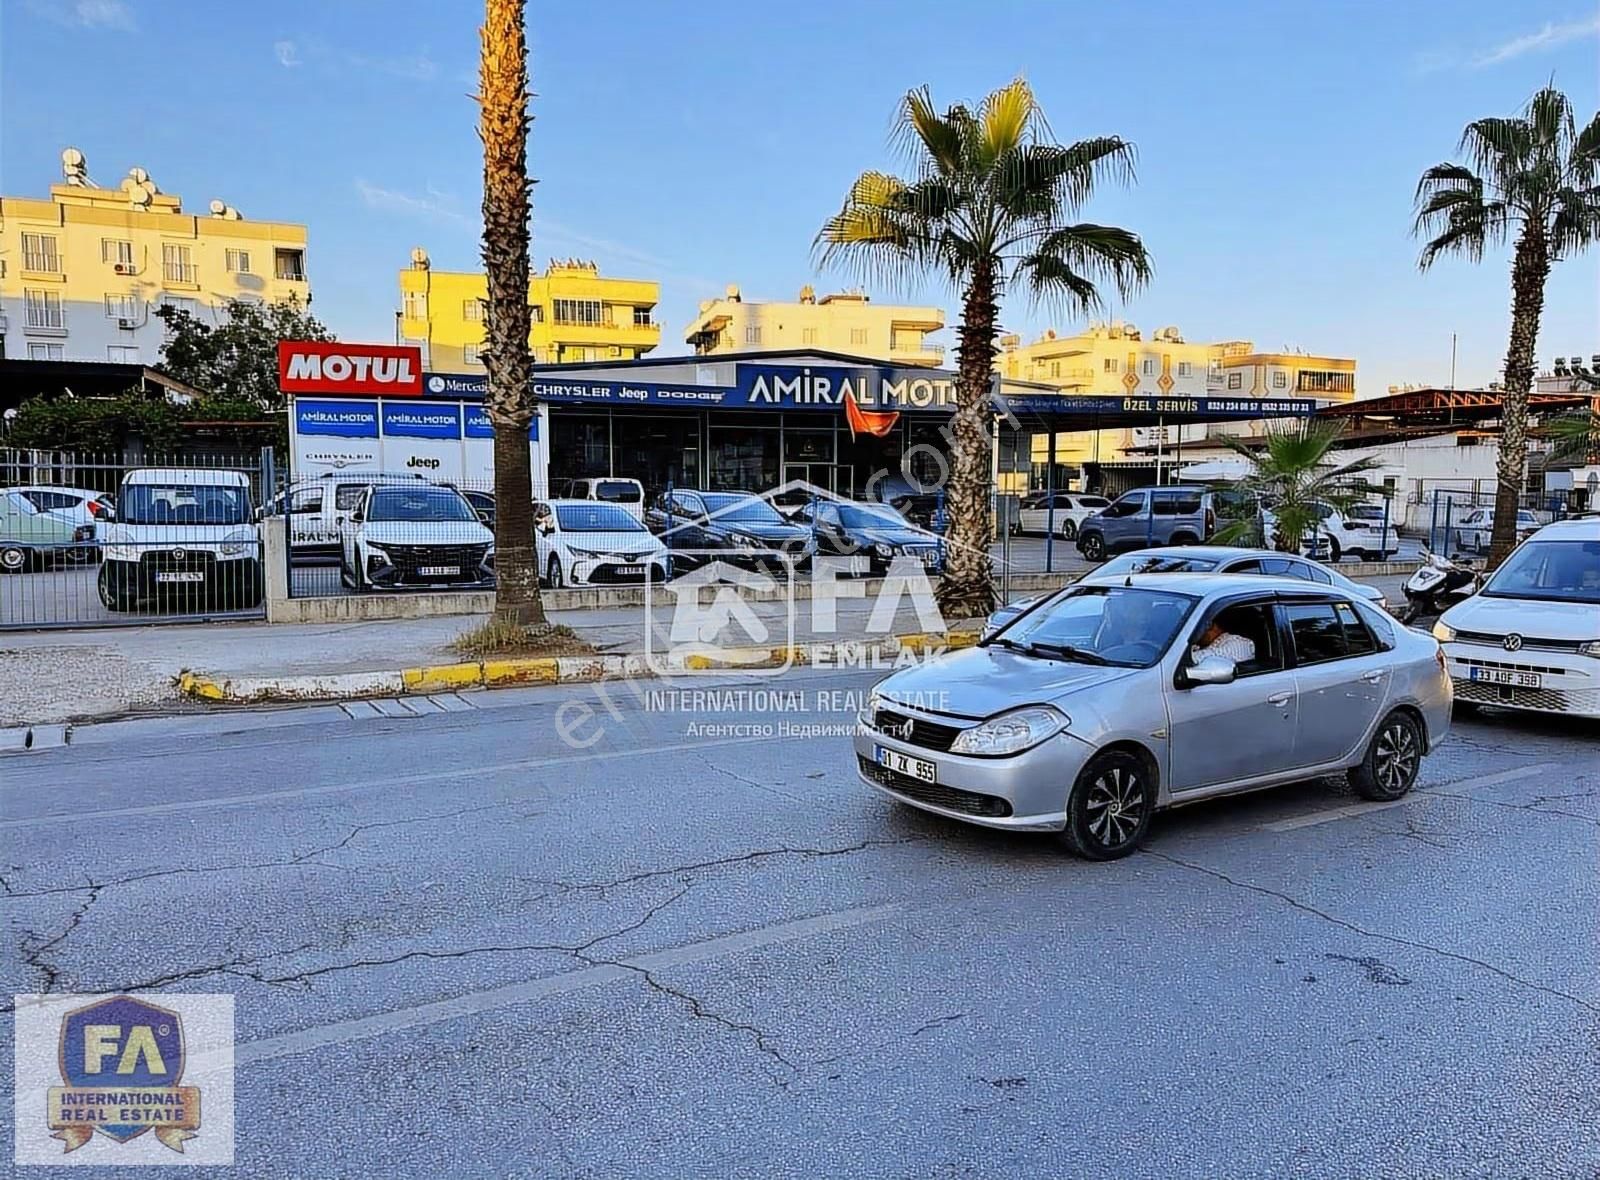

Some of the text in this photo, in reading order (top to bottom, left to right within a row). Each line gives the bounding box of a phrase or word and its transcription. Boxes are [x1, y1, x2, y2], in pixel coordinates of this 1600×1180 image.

[287, 354, 415, 384] MOTUL
[533, 384, 611, 398] CHRYSLER
[618, 386, 648, 400] Jeep
[657, 390, 723, 402] DODGE
[882, 378, 959, 408] MOT
[1123, 397, 1152, 411] ÖZEL
[1156, 399, 1198, 412] SERVİS
[340, 414, 375, 423] MOTOR
[424, 415, 457, 425] MOTOR
[468, 415, 492, 426] AMİR
[306, 453, 374, 461] CHRYSLER
[407, 456, 440, 469] Jeep
[1478, 670, 1491, 681] 33
[897, 756, 909, 773] ZK
[916, 761, 934, 782] 955
